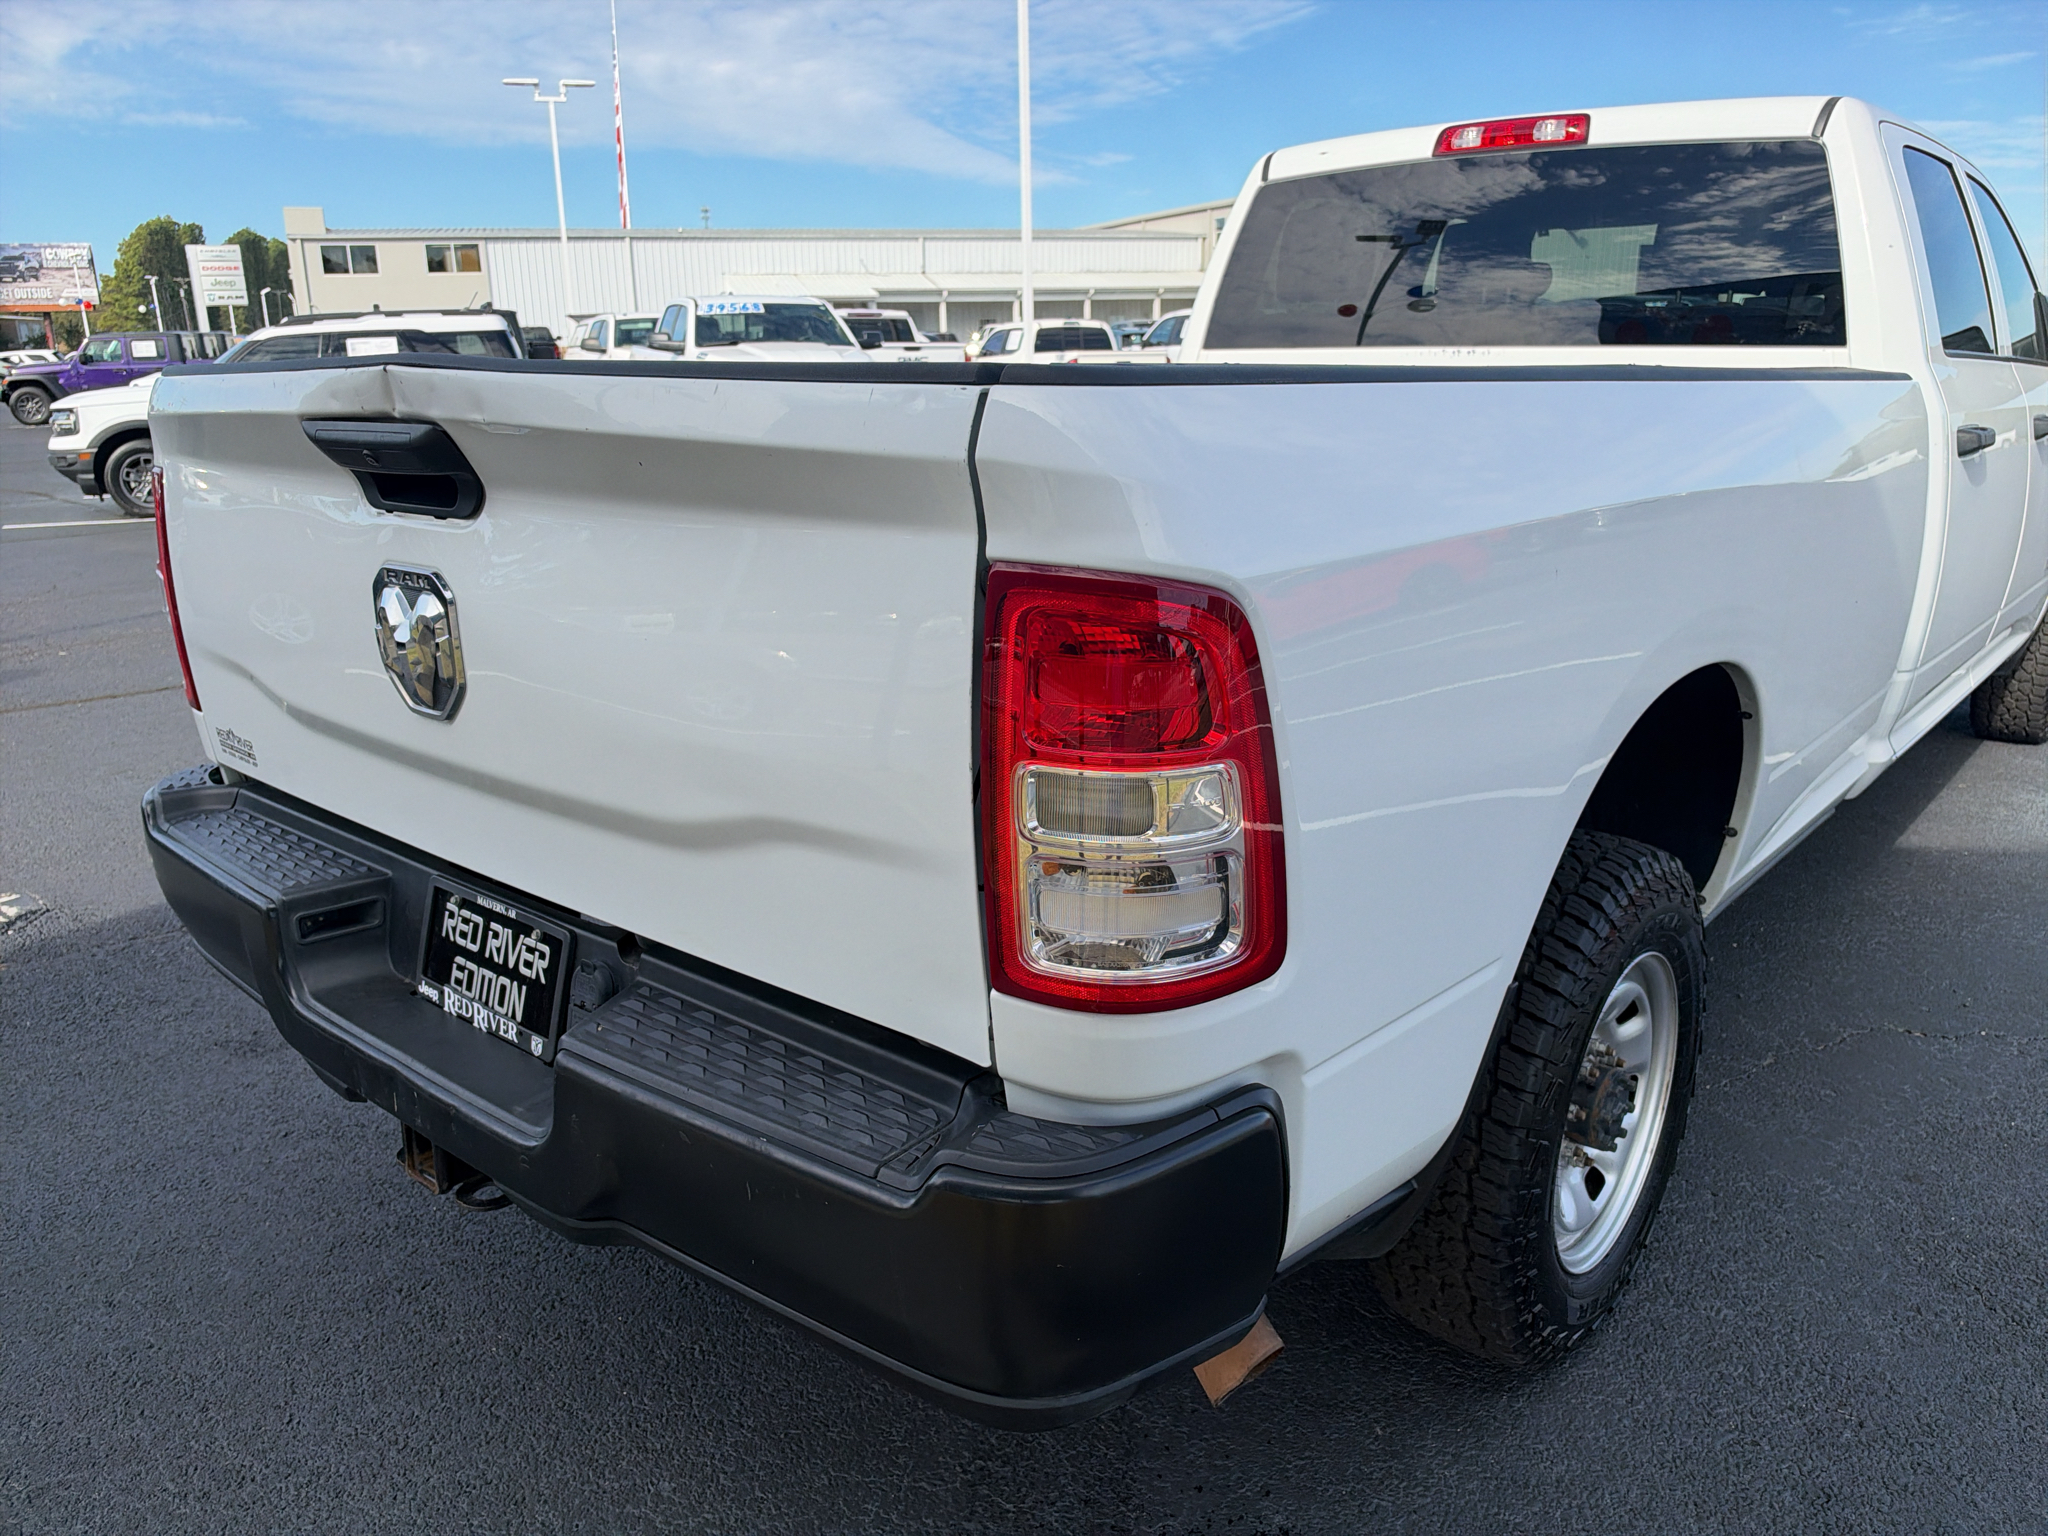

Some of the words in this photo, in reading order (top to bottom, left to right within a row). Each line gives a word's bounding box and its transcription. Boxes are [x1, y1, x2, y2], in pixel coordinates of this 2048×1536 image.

[211, 278, 236, 287] Jeep
[14, 287, 53, 299] OUTSIDE
[383, 569, 431, 589] RAM
[507, 908, 517, 919] AR
[441, 902, 483, 953] RED
[484, 921, 550, 985] RIVER
[450, 955, 527, 1023] EDITION
